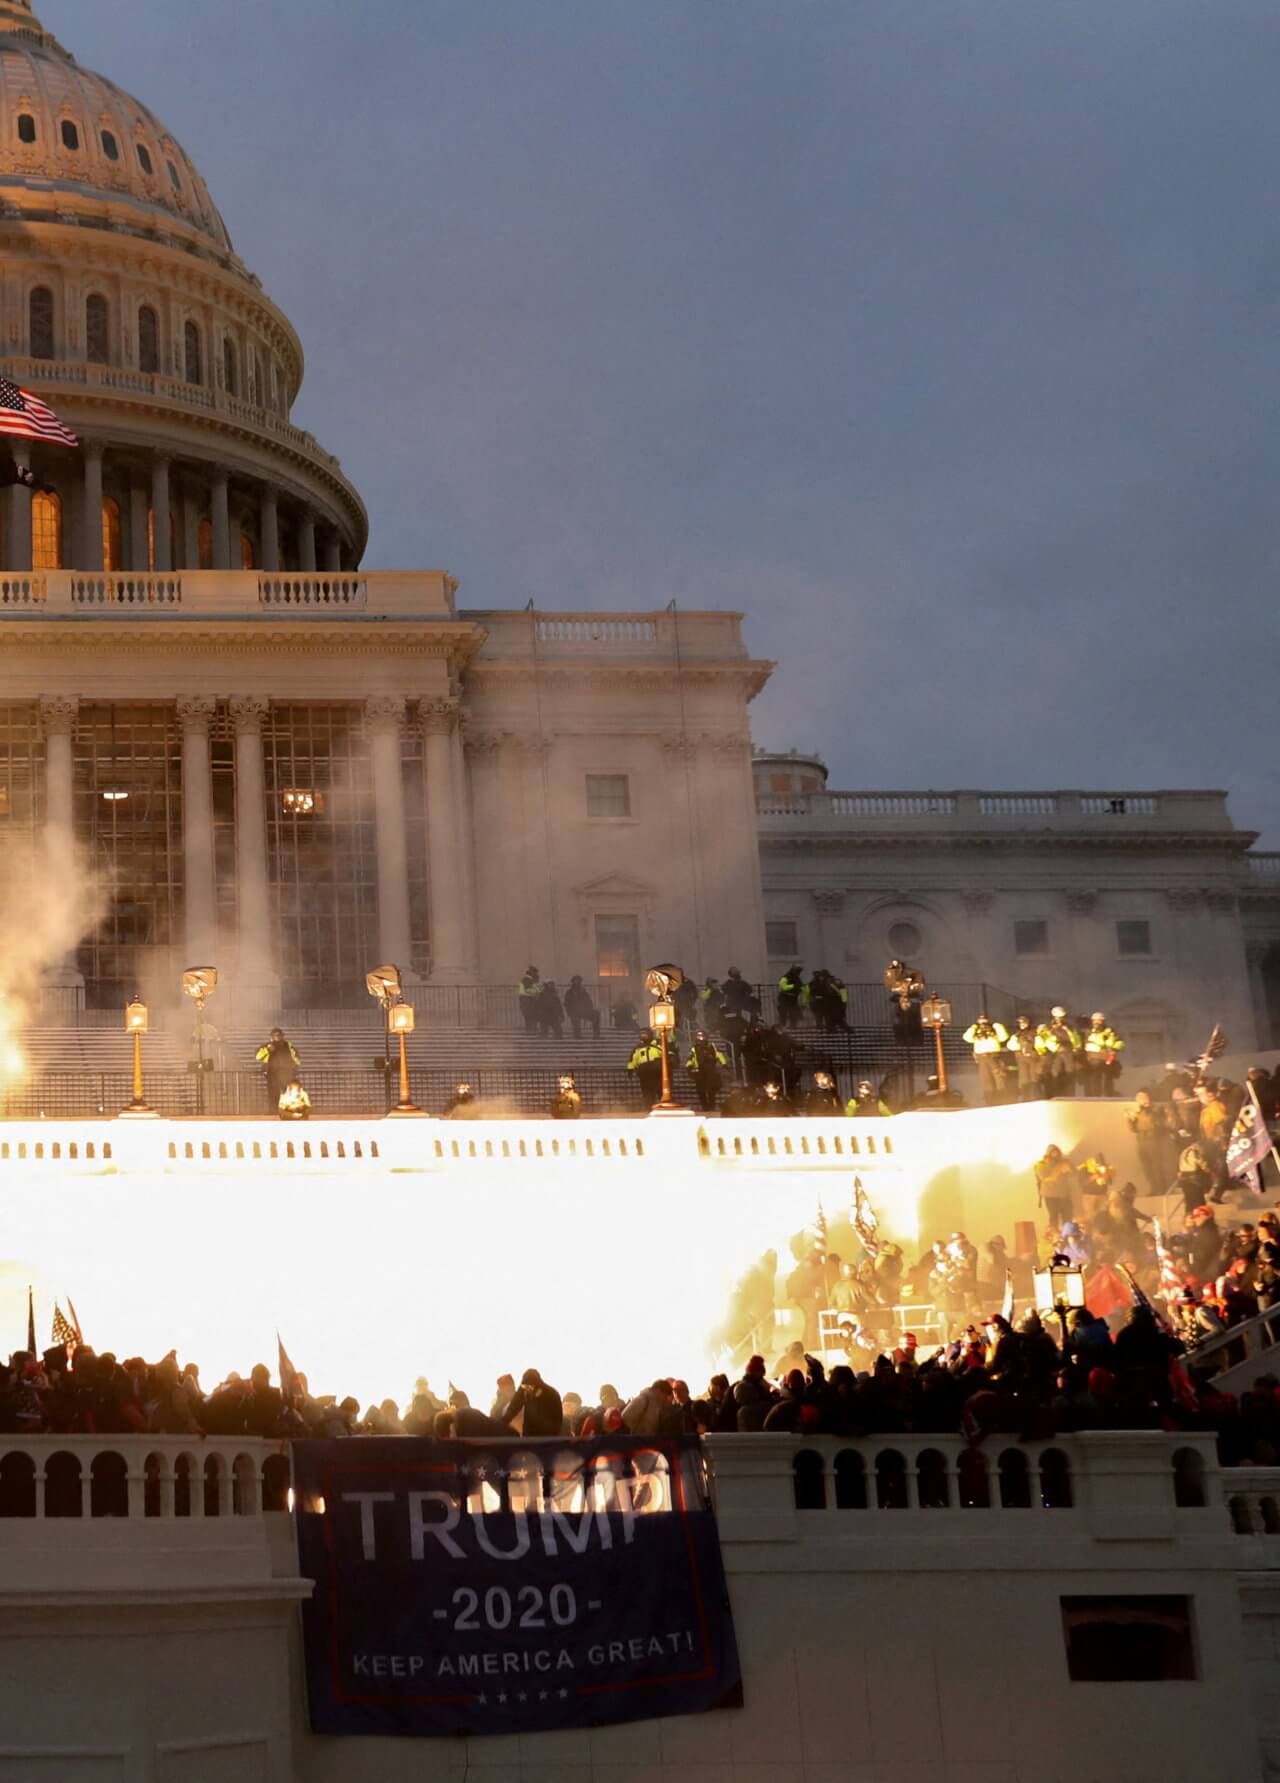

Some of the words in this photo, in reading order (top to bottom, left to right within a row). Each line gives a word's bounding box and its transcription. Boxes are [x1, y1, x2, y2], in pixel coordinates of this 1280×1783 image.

[341, 1474, 666, 1561] TRUMP
[352, 1653, 424, 1679] KEEP
[437, 1647, 575, 1678] AMERICA
[588, 1630, 696, 1665] GREAT!
